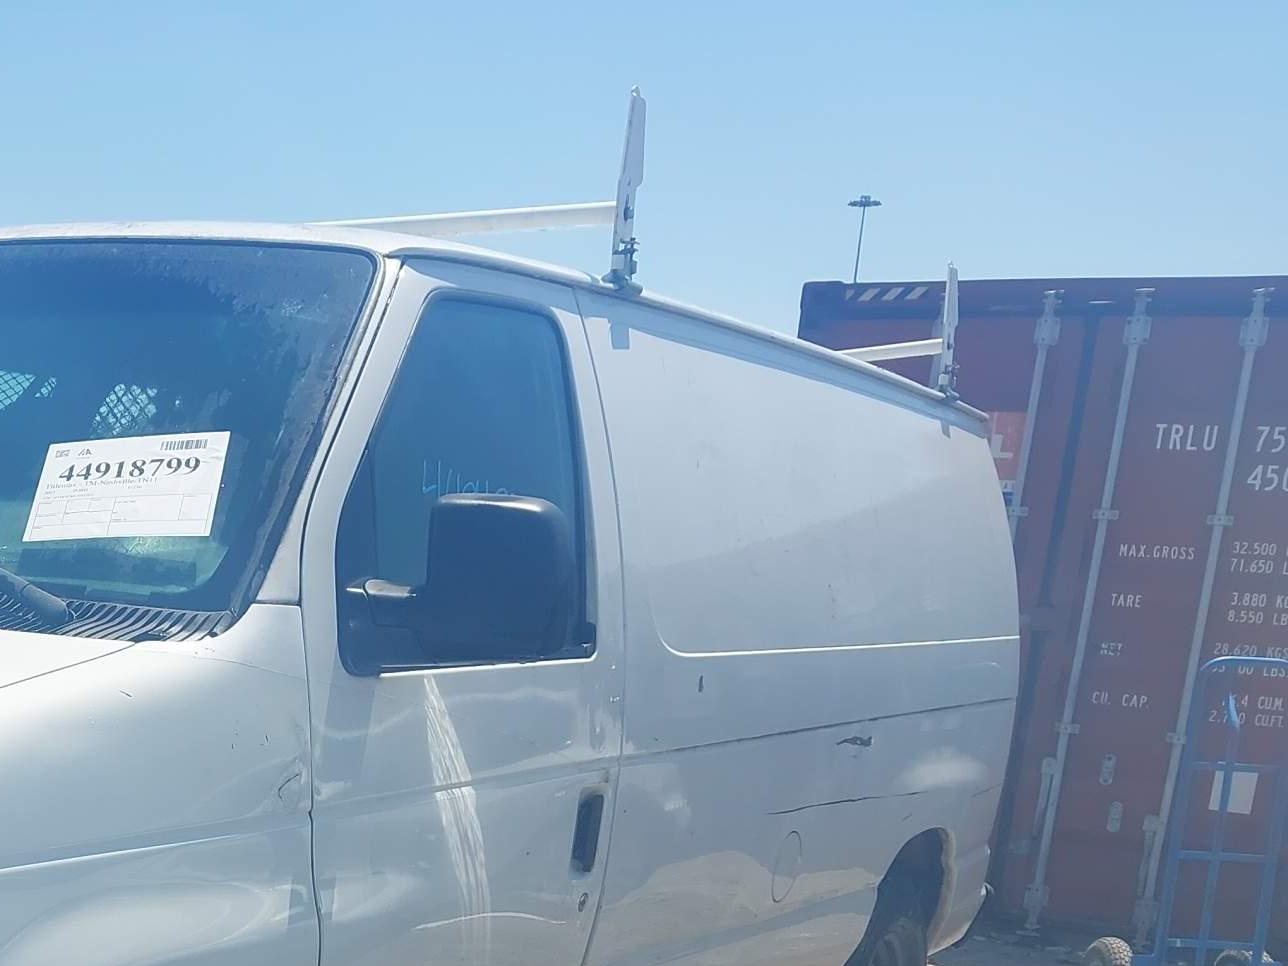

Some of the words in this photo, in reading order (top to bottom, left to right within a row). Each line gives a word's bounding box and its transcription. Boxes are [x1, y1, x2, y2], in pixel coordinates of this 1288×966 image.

[1155, 423, 1219, 451] TRLU
[58, 456, 201, 482] 44918799
[1232, 541, 1277, 556] 32.500
[1230, 558, 1274, 574] 71.650
[1111, 593, 1143, 608] TARE
[1231, 591, 1267, 608] 3.880
[1227, 608, 1264, 625] 8.550
[1100, 642, 1123, 656] NET
[1213, 642, 1257, 658] 28.620
